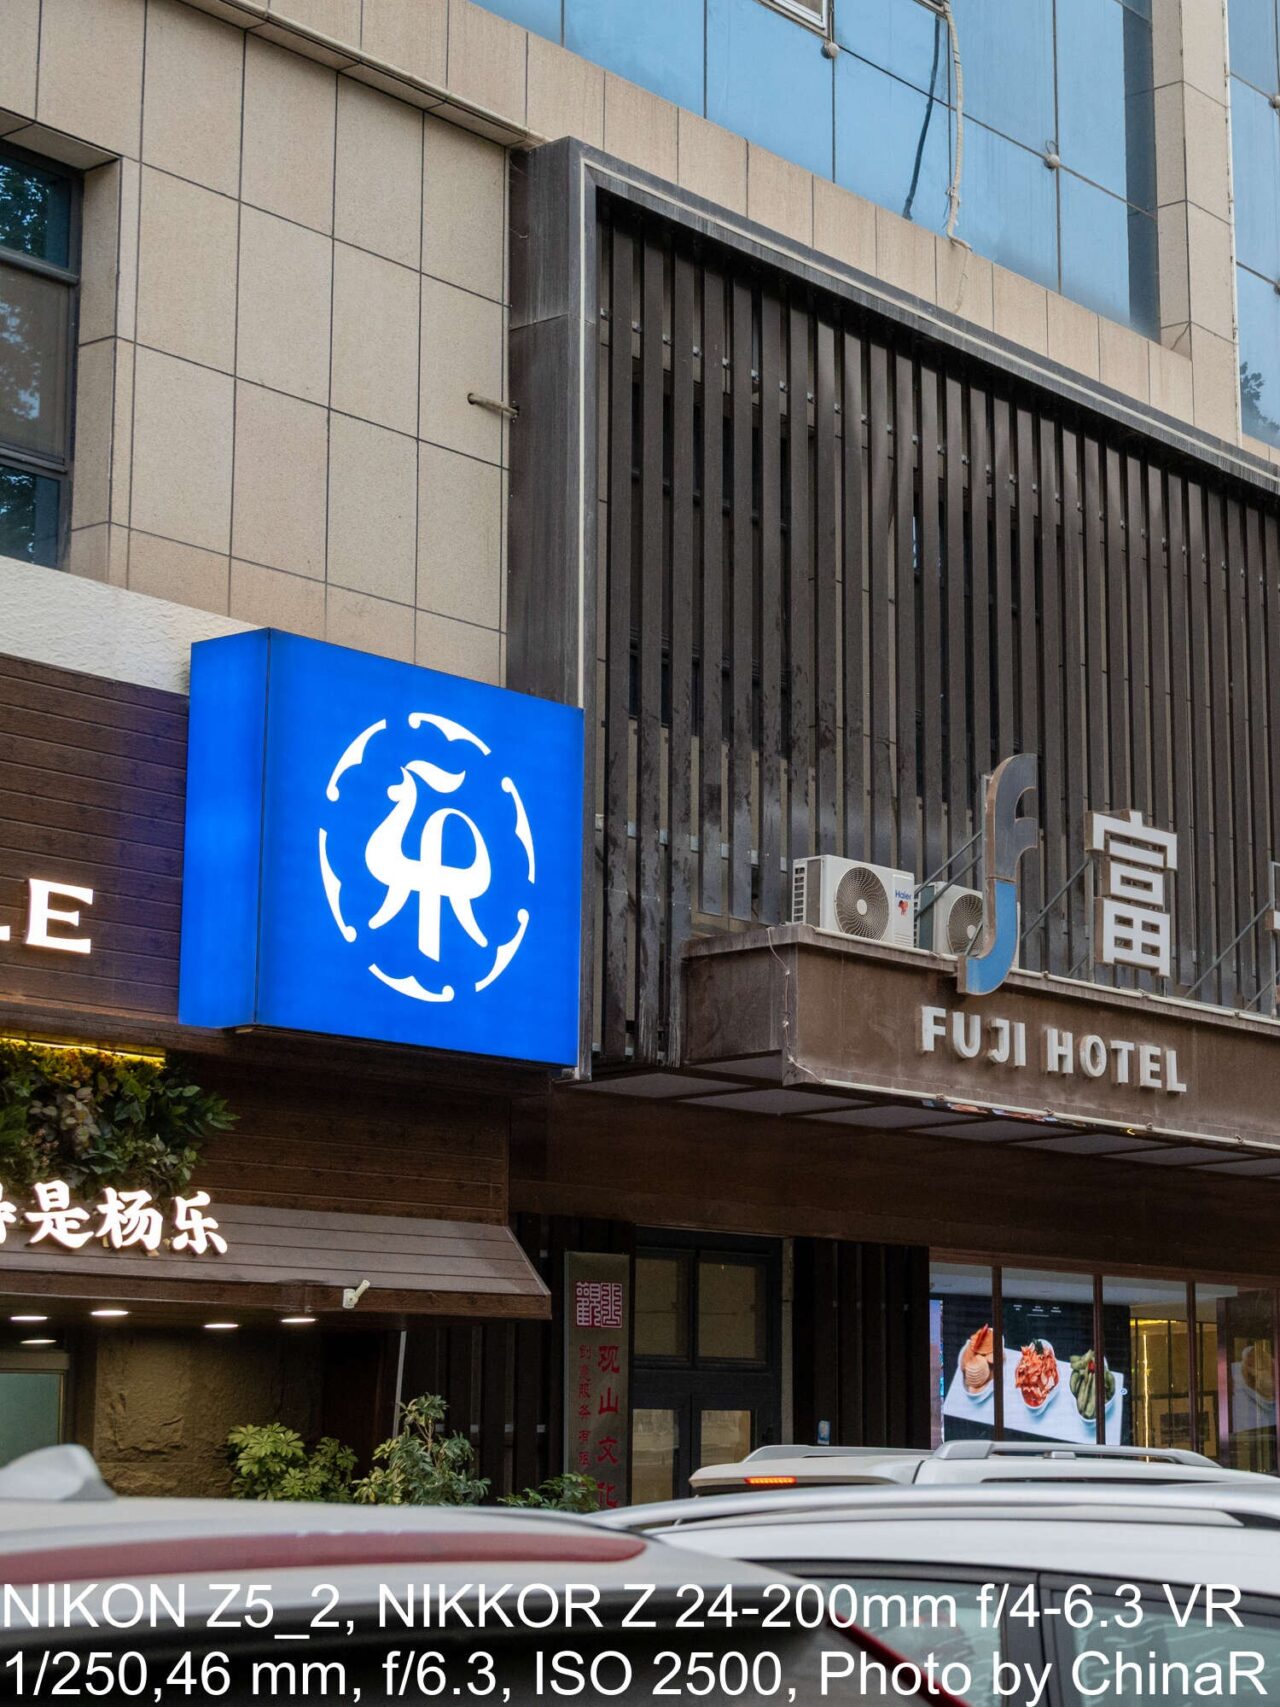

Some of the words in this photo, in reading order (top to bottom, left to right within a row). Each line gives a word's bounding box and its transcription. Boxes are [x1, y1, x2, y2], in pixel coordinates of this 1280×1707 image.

[0, 878, 94, 954] E
[894, 888, 912, 899] Haier
[920, 1005, 1027, 1067] FUJI
[1046, 1027, 1187, 1093] HOTEL
[597, 1345, 621, 1509] 观山文化
